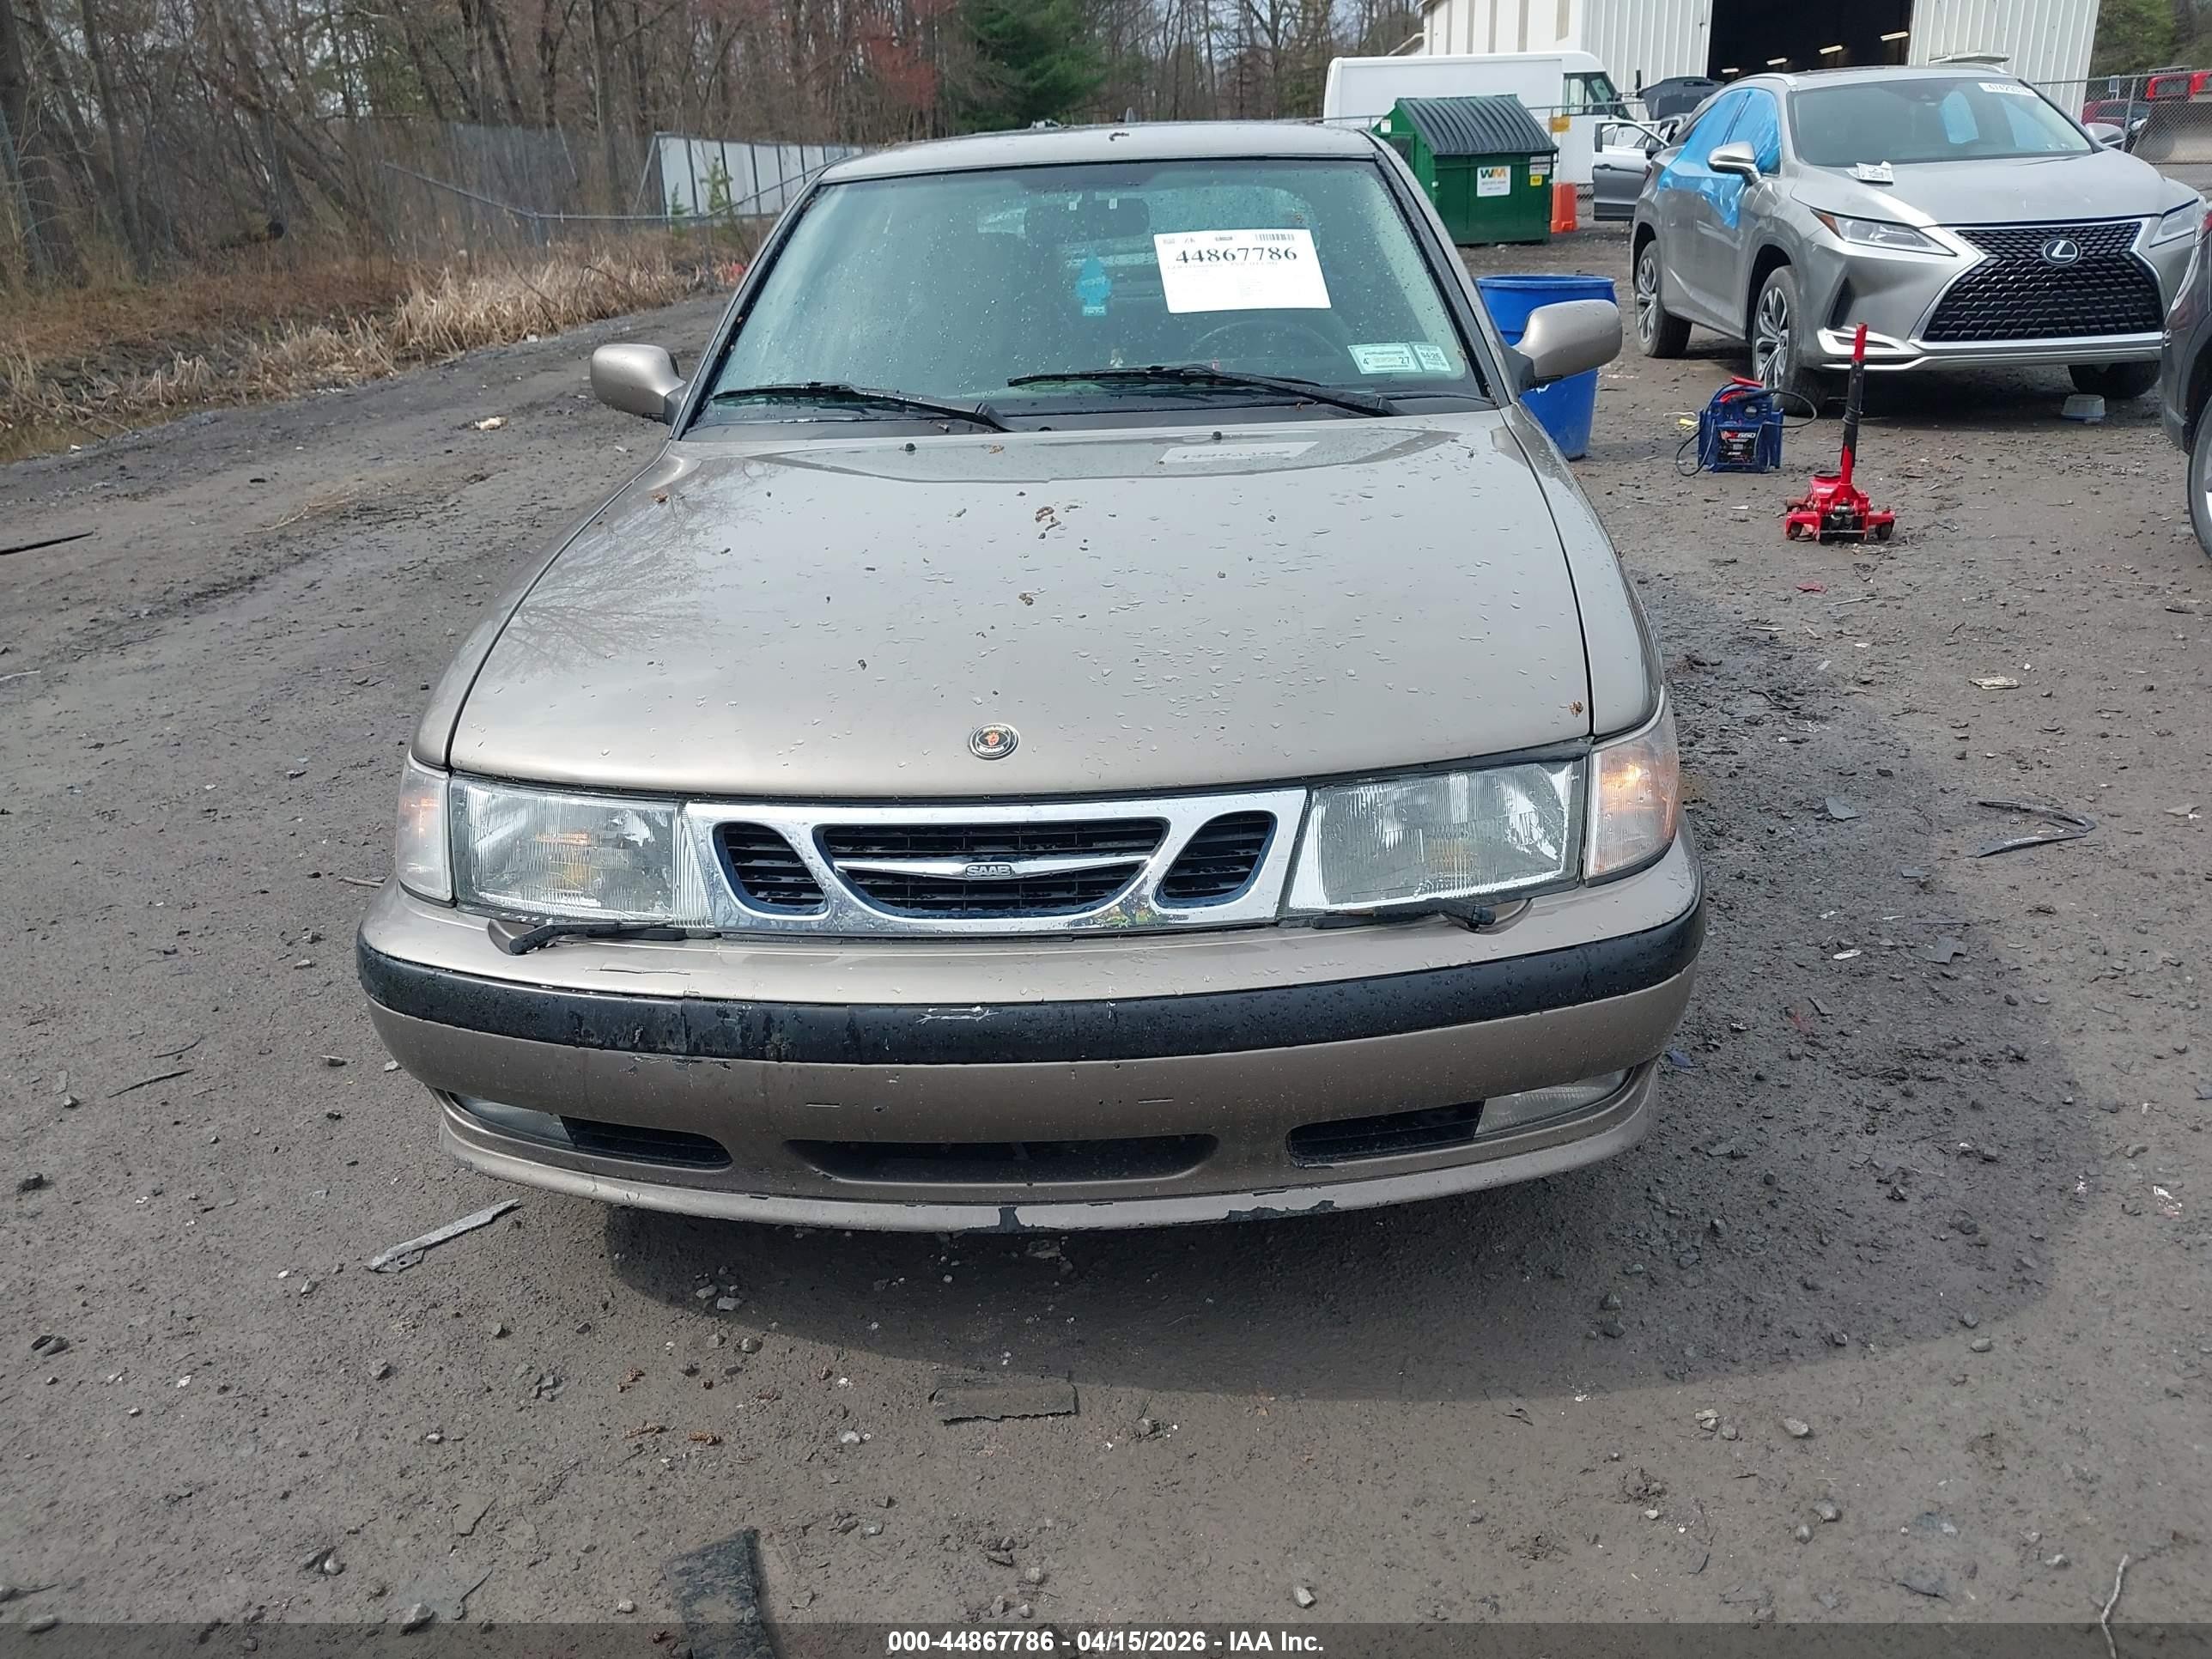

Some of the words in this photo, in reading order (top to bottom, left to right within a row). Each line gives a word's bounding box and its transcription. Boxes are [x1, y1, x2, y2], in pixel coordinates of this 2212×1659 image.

[1480, 167, 1507, 179] WM
[1176, 246, 1297, 264] 44867786
[966, 865, 1012, 877] SAAB
